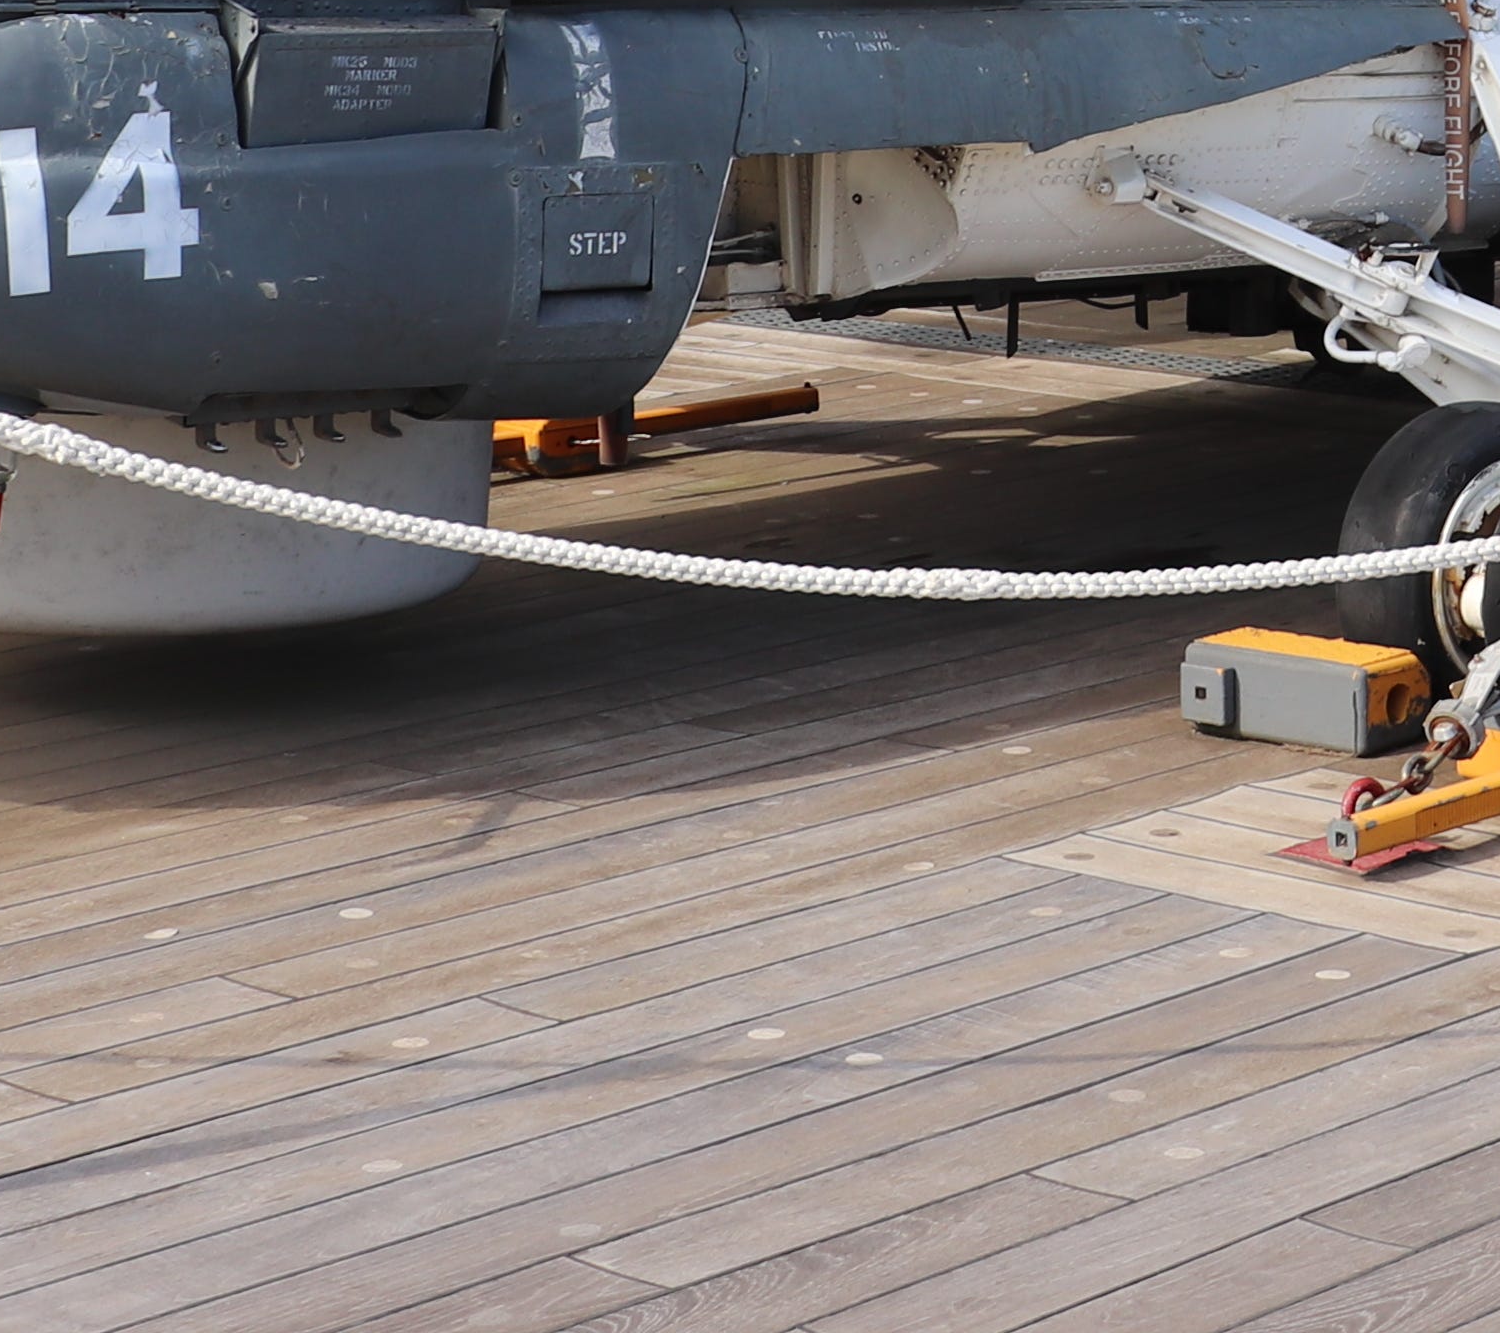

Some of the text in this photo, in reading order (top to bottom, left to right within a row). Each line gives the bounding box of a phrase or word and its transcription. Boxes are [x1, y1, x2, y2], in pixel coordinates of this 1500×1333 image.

[345, 69, 398, 81] MARKER
[332, 98, 393, 110] ADAPTER
[568, 231, 628, 256] STEP
